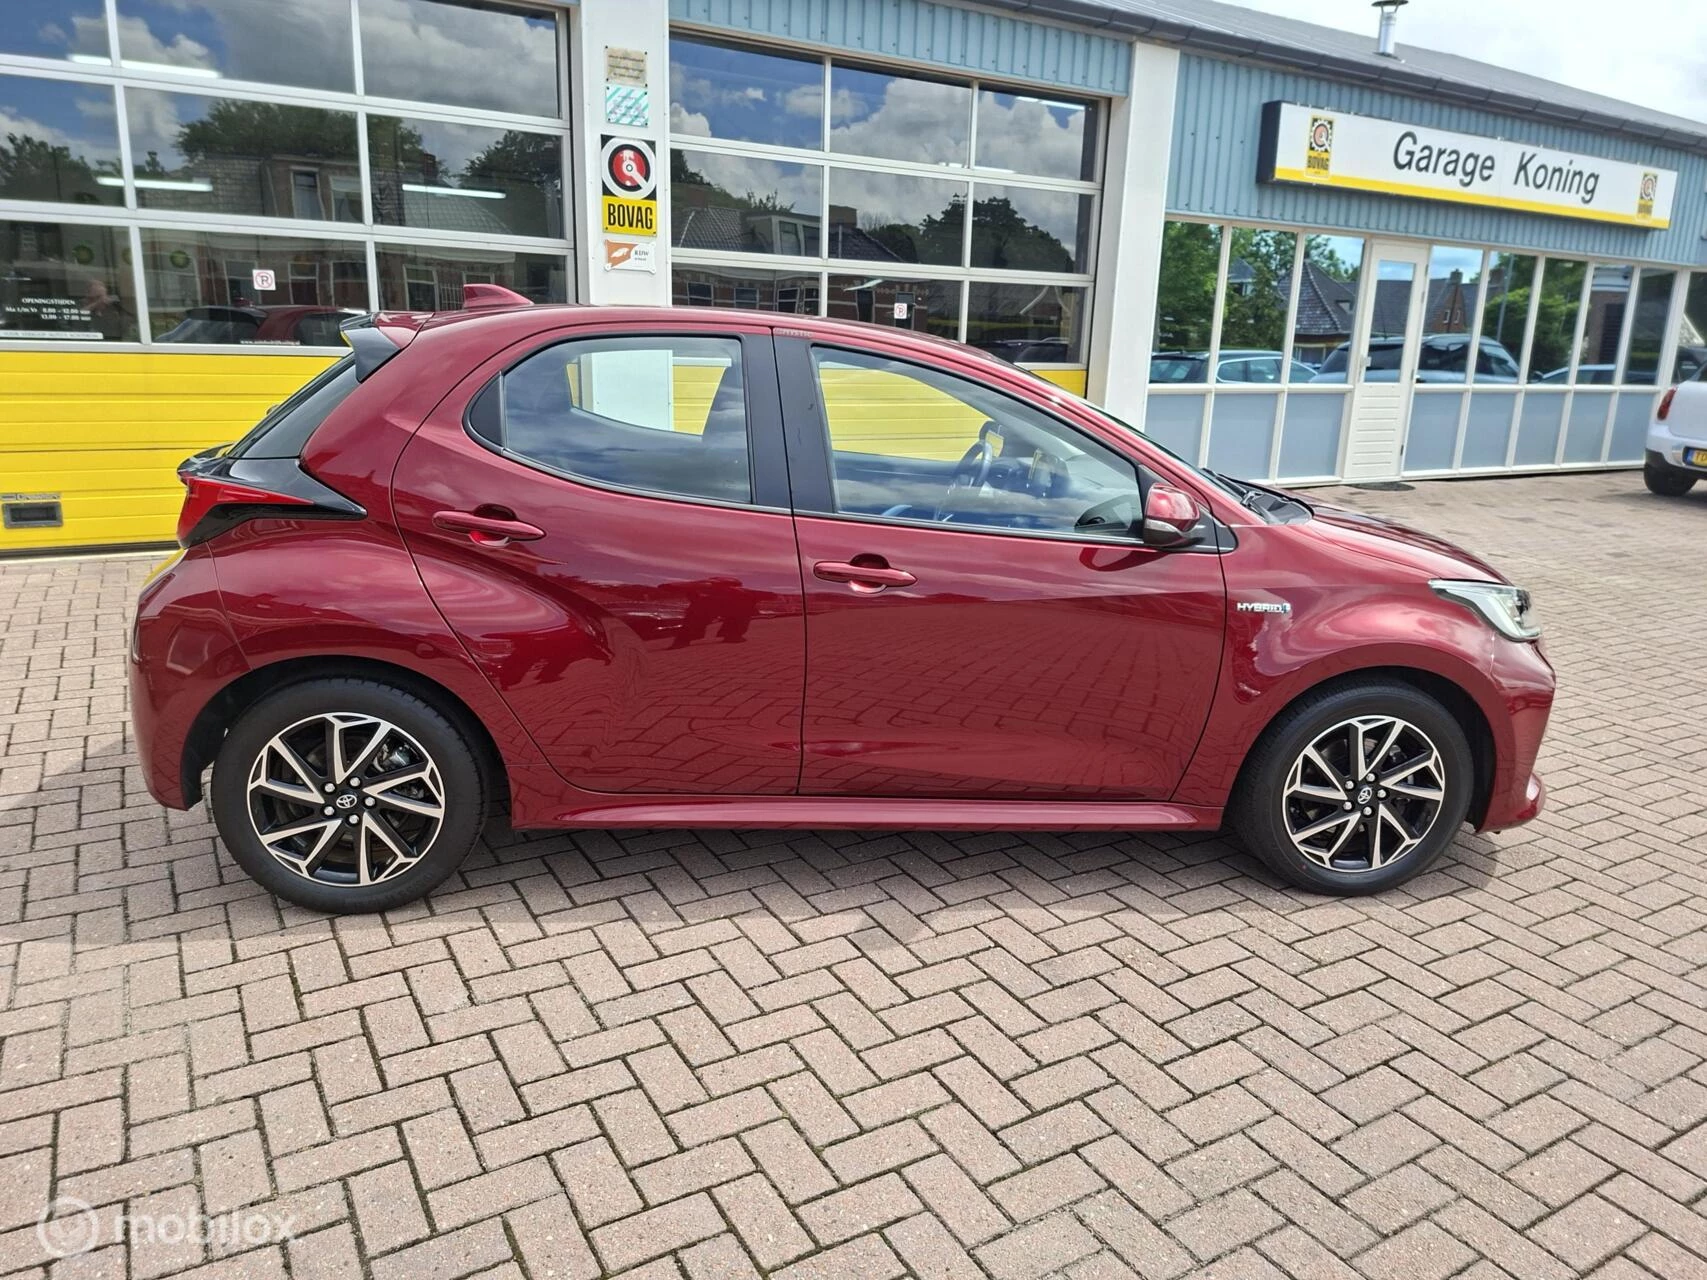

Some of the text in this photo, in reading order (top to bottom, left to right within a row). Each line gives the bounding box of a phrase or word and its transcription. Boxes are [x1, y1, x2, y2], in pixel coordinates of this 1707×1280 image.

[1307, 155, 1329, 170] BOVAG
[1393, 131, 1600, 205] Garage Koning
[607, 203, 654, 230] BOVAG
[1237, 603, 1282, 612] HYBRID
